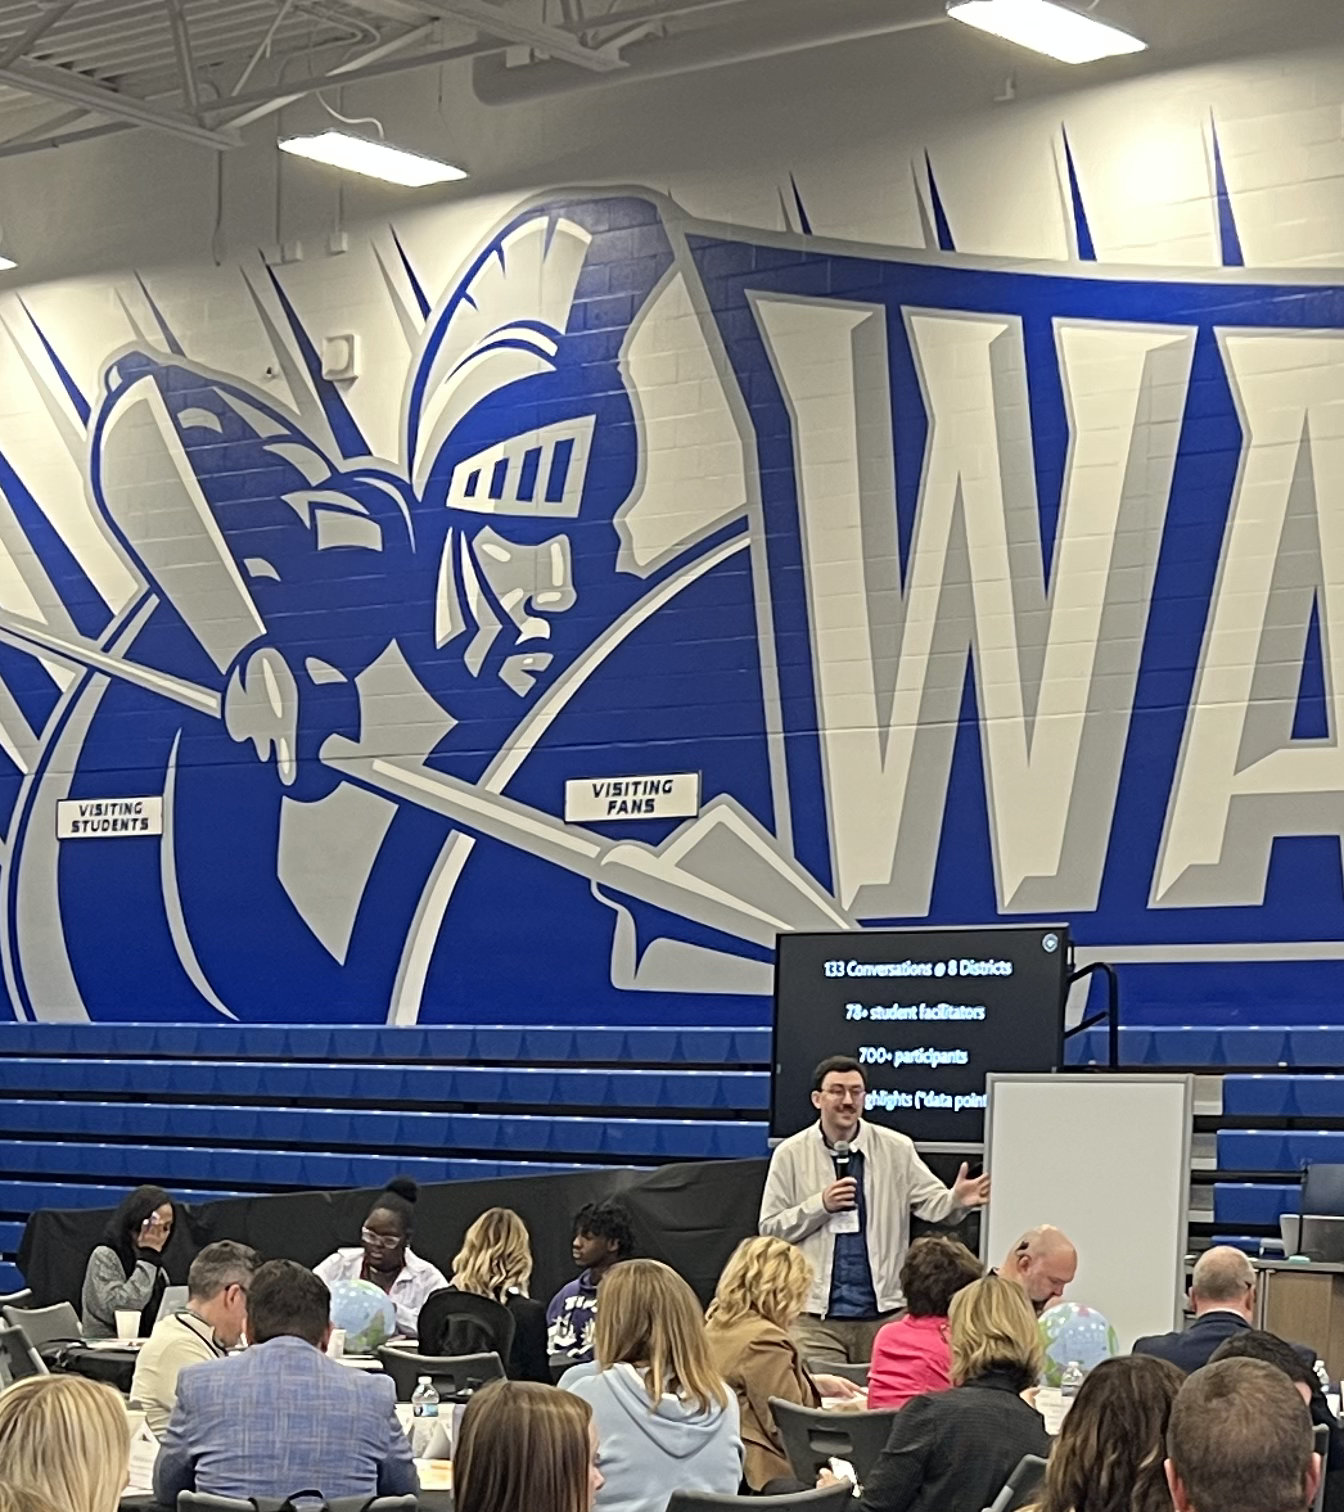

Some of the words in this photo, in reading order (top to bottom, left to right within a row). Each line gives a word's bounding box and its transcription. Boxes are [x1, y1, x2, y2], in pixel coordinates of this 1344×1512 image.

[591, 778, 674, 799] VISITING
[77, 800, 144, 818] VISITING
[606, 797, 656, 816] FANS
[70, 816, 150, 834] STUDENTS
[824, 961, 845, 977] 133
[847, 960, 932, 978] Conversations
[947, 960, 958, 976] 8
[959, 959, 1013, 977] Districts
[845, 1003, 869, 1021] 78+
[870, 1004, 917, 1021] student
[918, 1004, 986, 1021] facilitators
[859, 1047, 893, 1065] 700+
[894, 1047, 968, 1069] participants
[864, 1090, 913, 1111] ghlights
